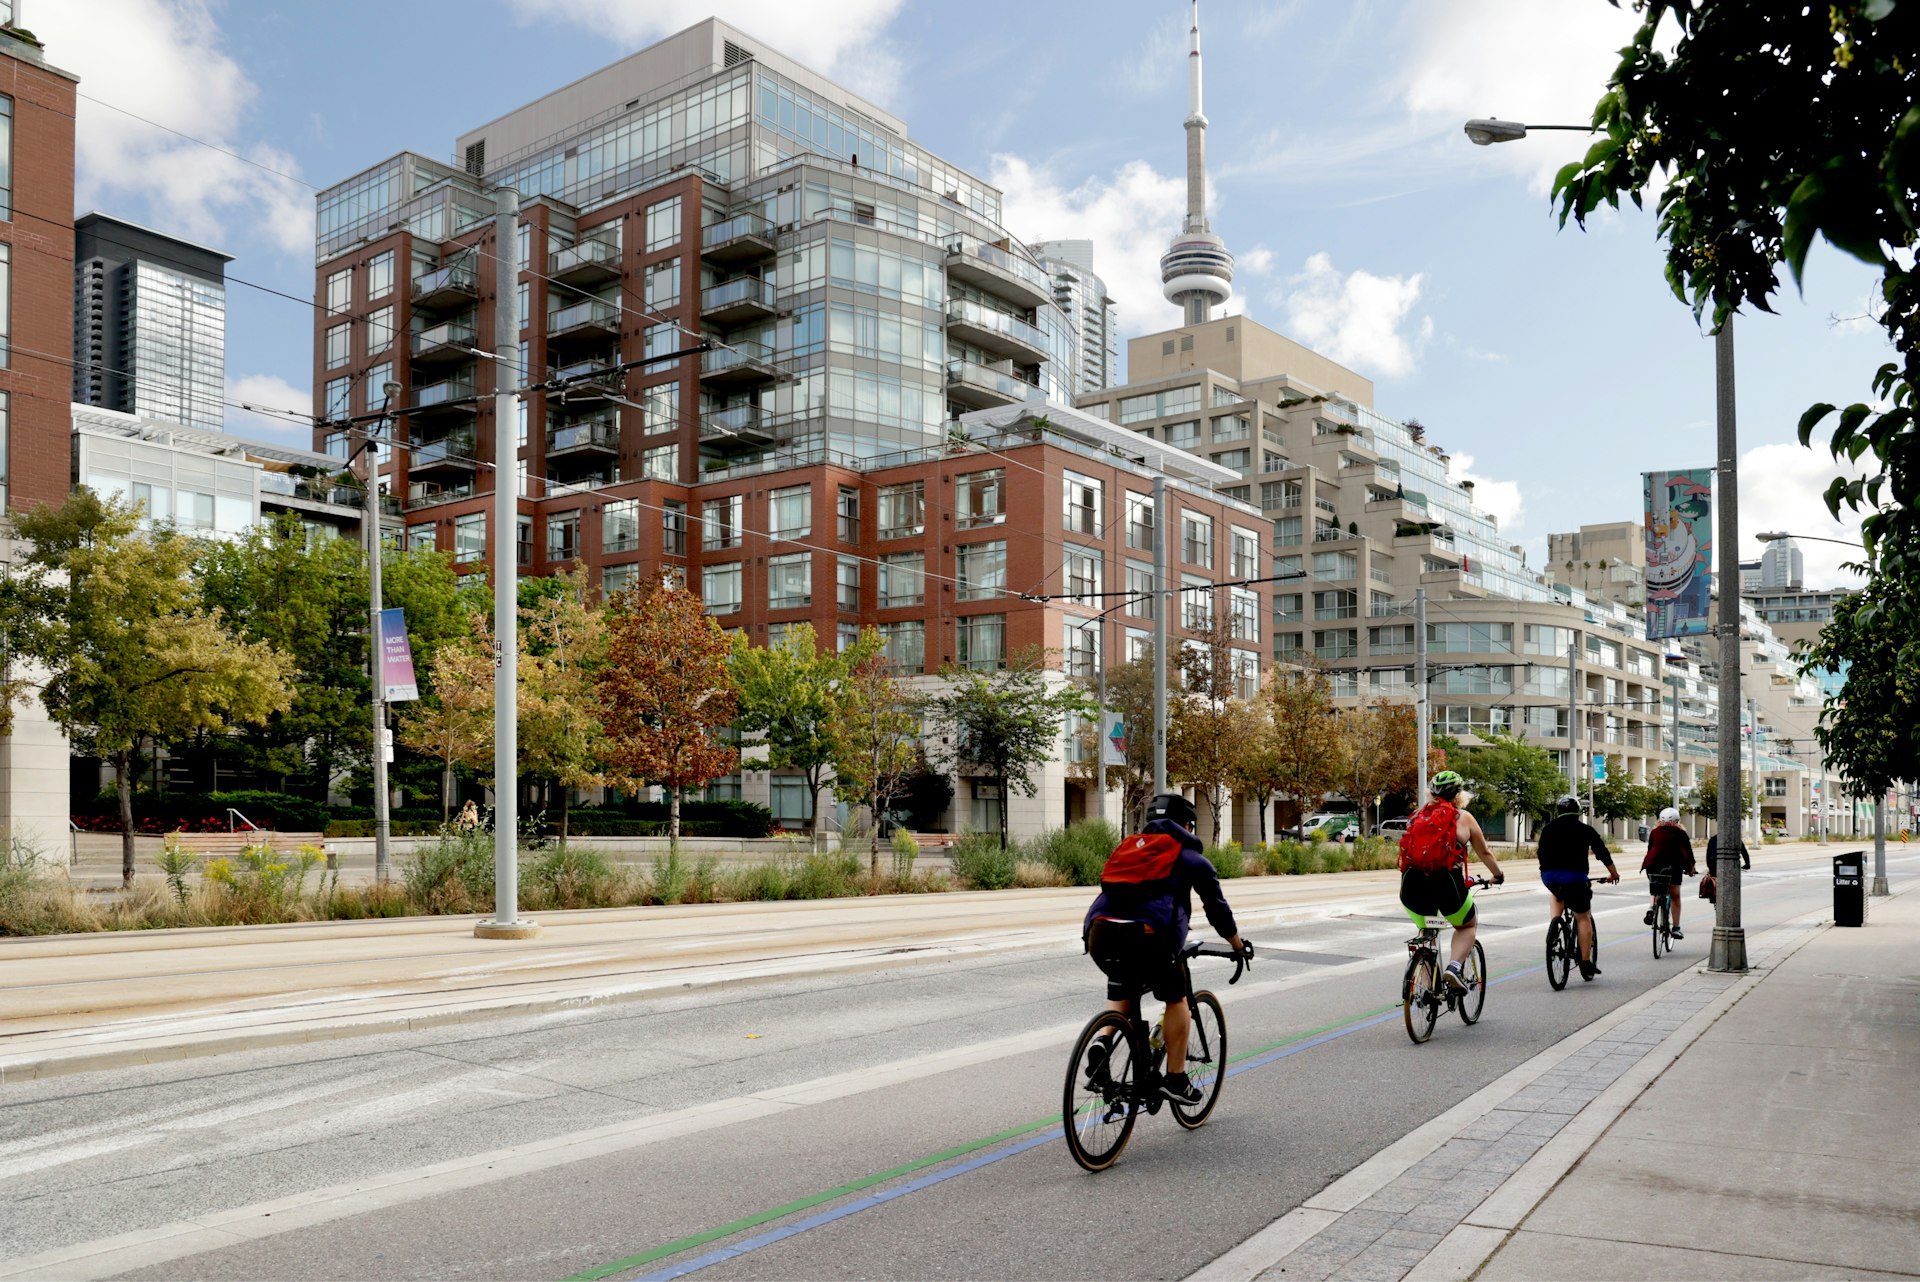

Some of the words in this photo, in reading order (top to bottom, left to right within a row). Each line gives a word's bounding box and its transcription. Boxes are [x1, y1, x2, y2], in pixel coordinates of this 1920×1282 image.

[386, 635, 404, 644] MORE
[386, 645, 405, 654] THAN
[387, 655, 410, 663] WATER
[1836, 878, 1851, 886] Litter
